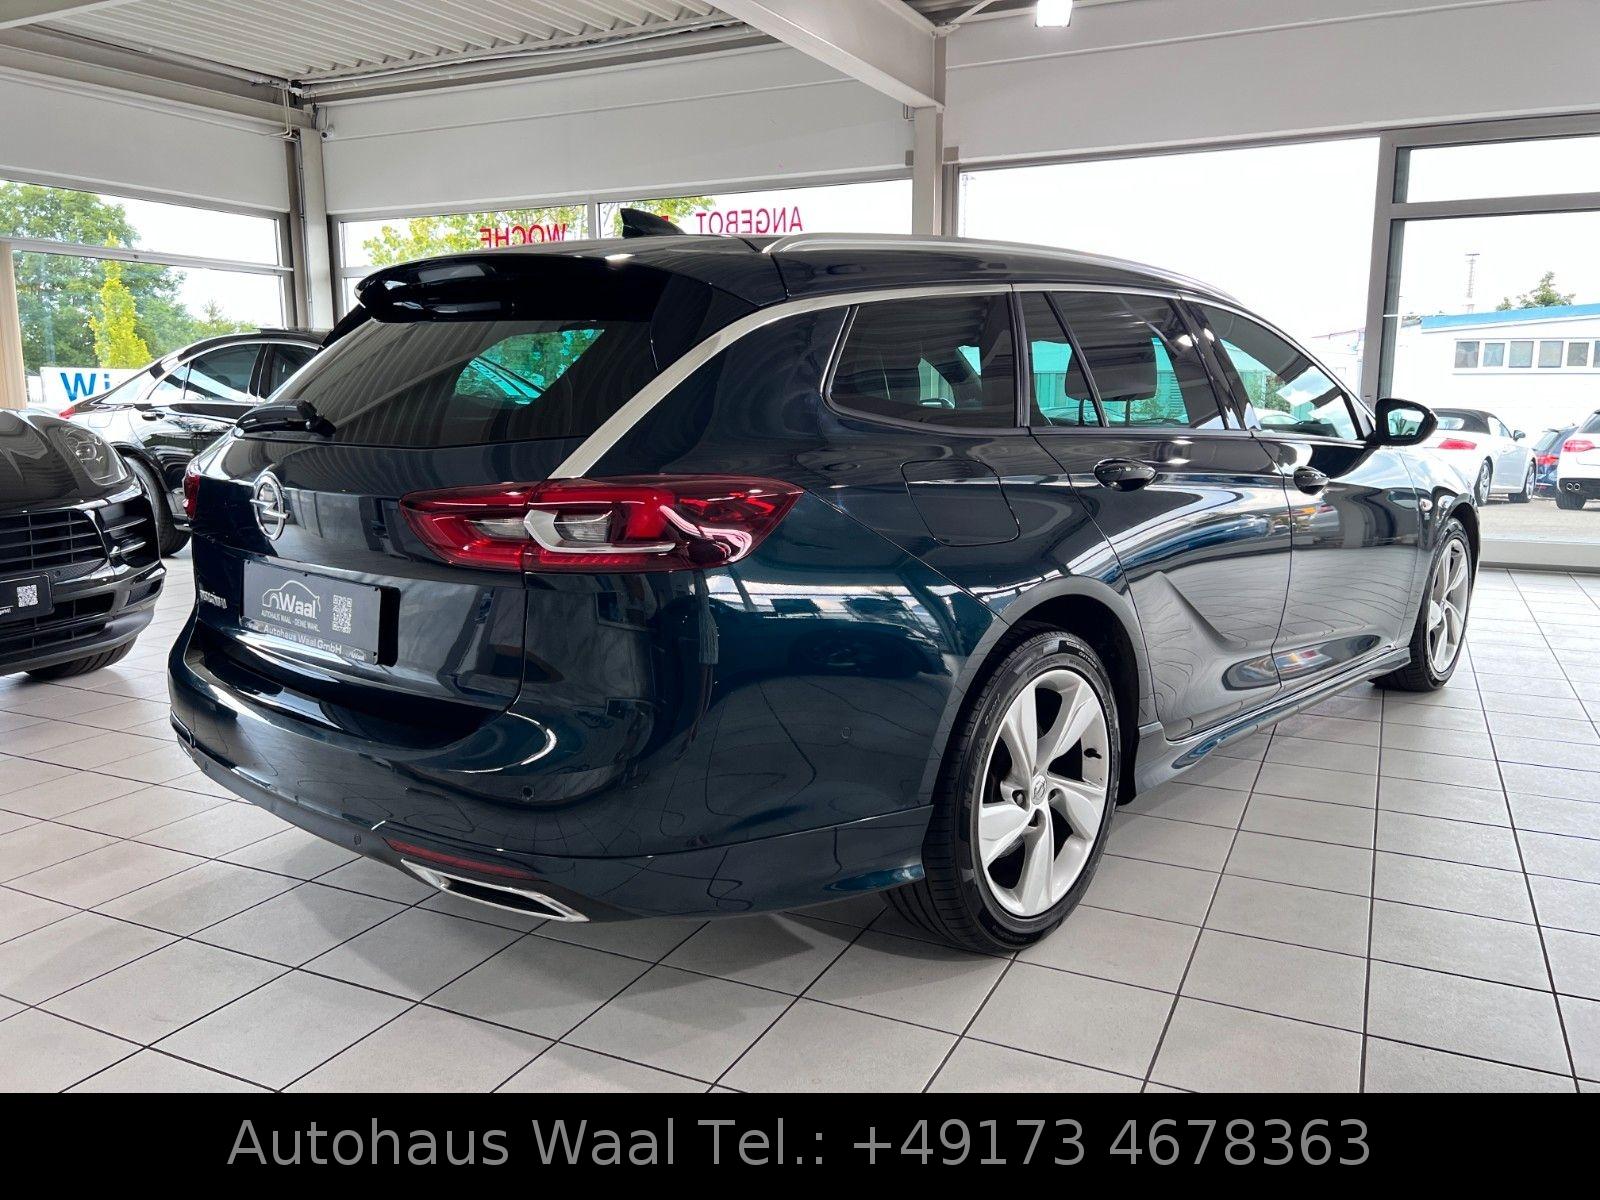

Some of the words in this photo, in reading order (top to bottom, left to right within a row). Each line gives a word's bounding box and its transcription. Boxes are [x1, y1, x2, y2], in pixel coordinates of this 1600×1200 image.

[279, 592, 317, 619] Waal
[263, 624, 297, 641] Autohaus
[298, 633, 317, 648] Waal
[317, 639, 342, 655] GmbH
